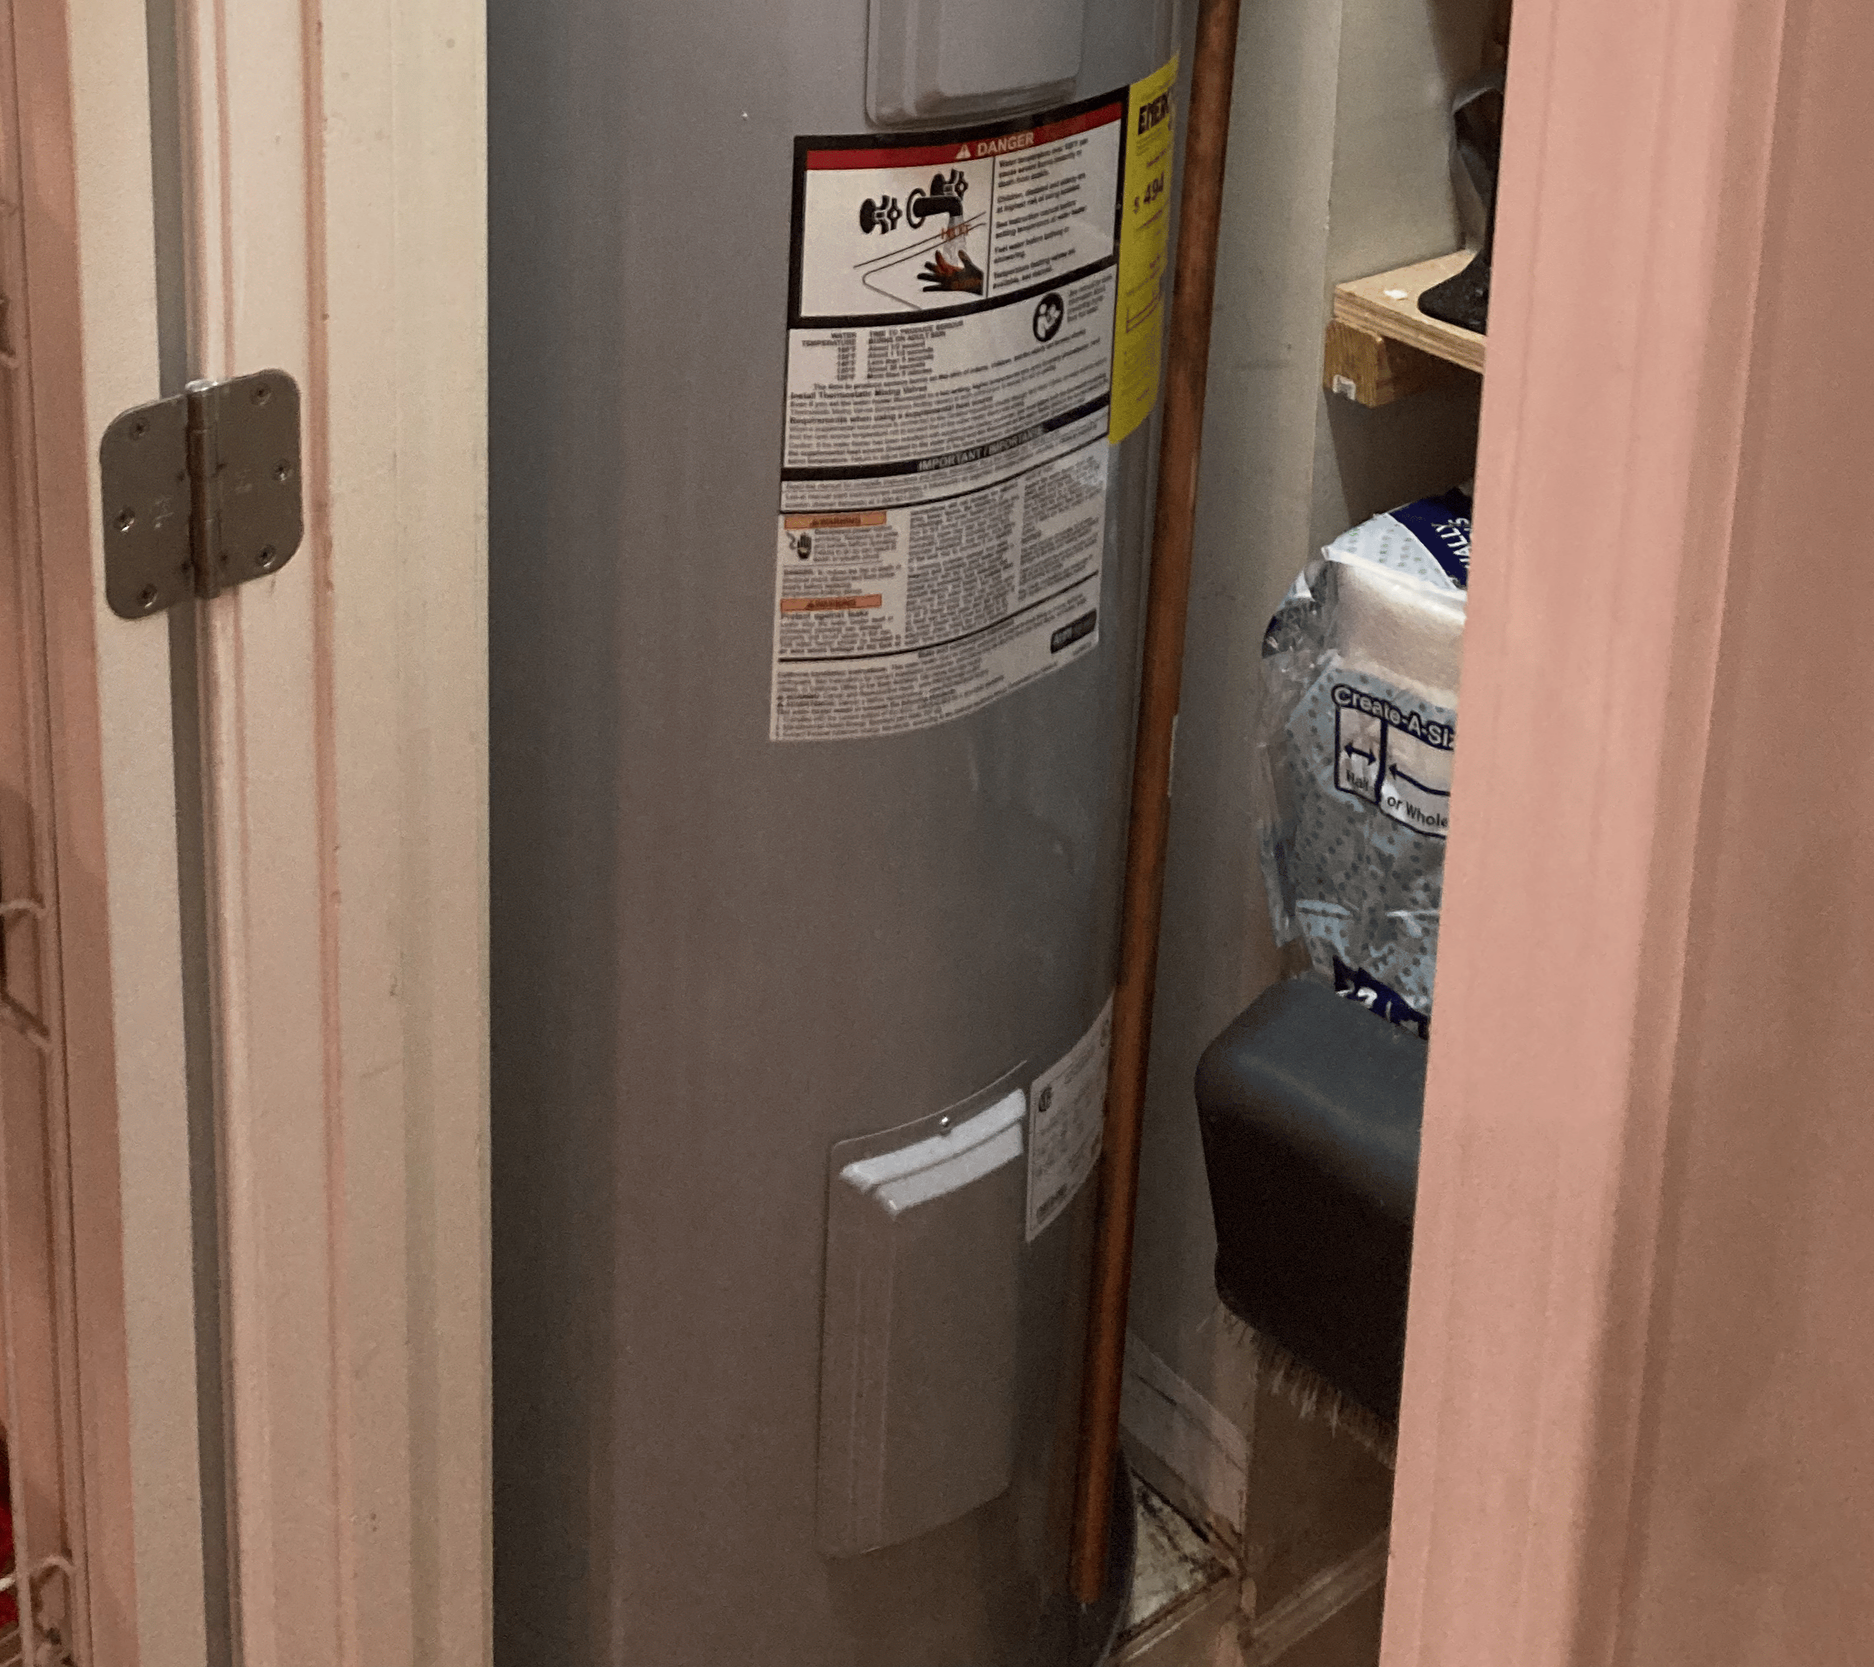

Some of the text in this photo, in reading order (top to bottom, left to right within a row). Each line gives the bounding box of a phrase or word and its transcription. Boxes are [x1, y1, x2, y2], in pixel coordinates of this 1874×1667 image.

[977, 132, 1035, 157] DANGER
[918, 448, 982, 472] IMPORTANT
[1387, 795, 1402, 811] or
